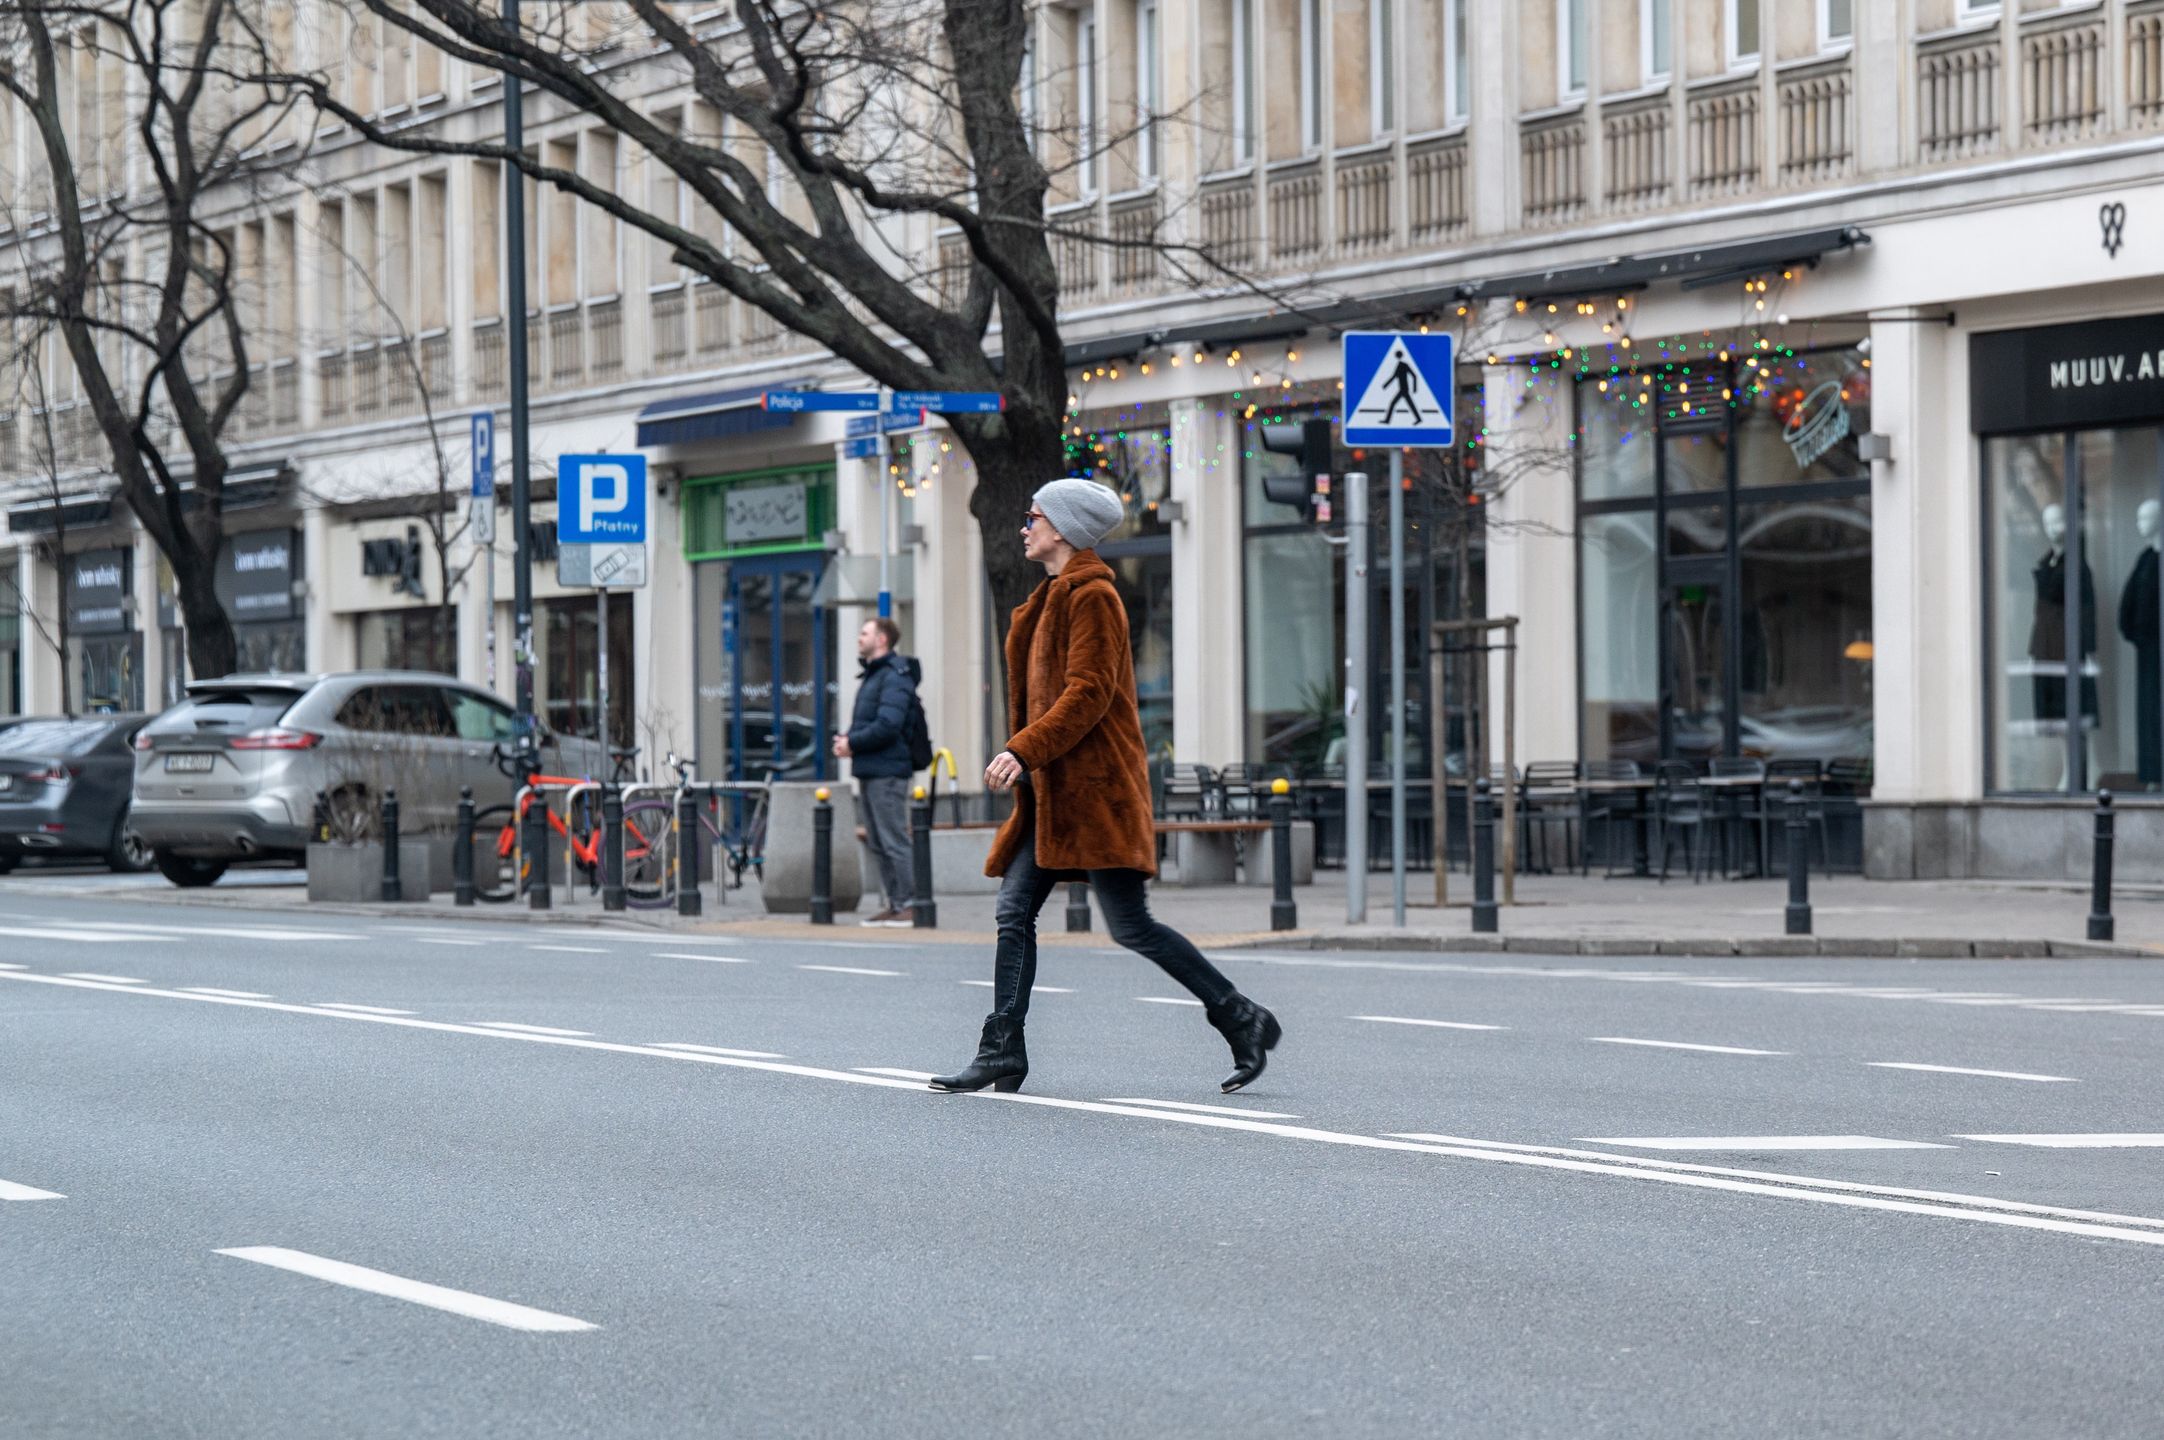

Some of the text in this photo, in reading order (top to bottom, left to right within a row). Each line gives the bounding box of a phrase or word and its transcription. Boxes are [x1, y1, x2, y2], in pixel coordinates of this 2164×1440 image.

[769, 395, 804, 412] Policja
[475, 418, 489, 474] P
[579, 464, 628, 532] P
[594, 519, 639, 534] Płatny
